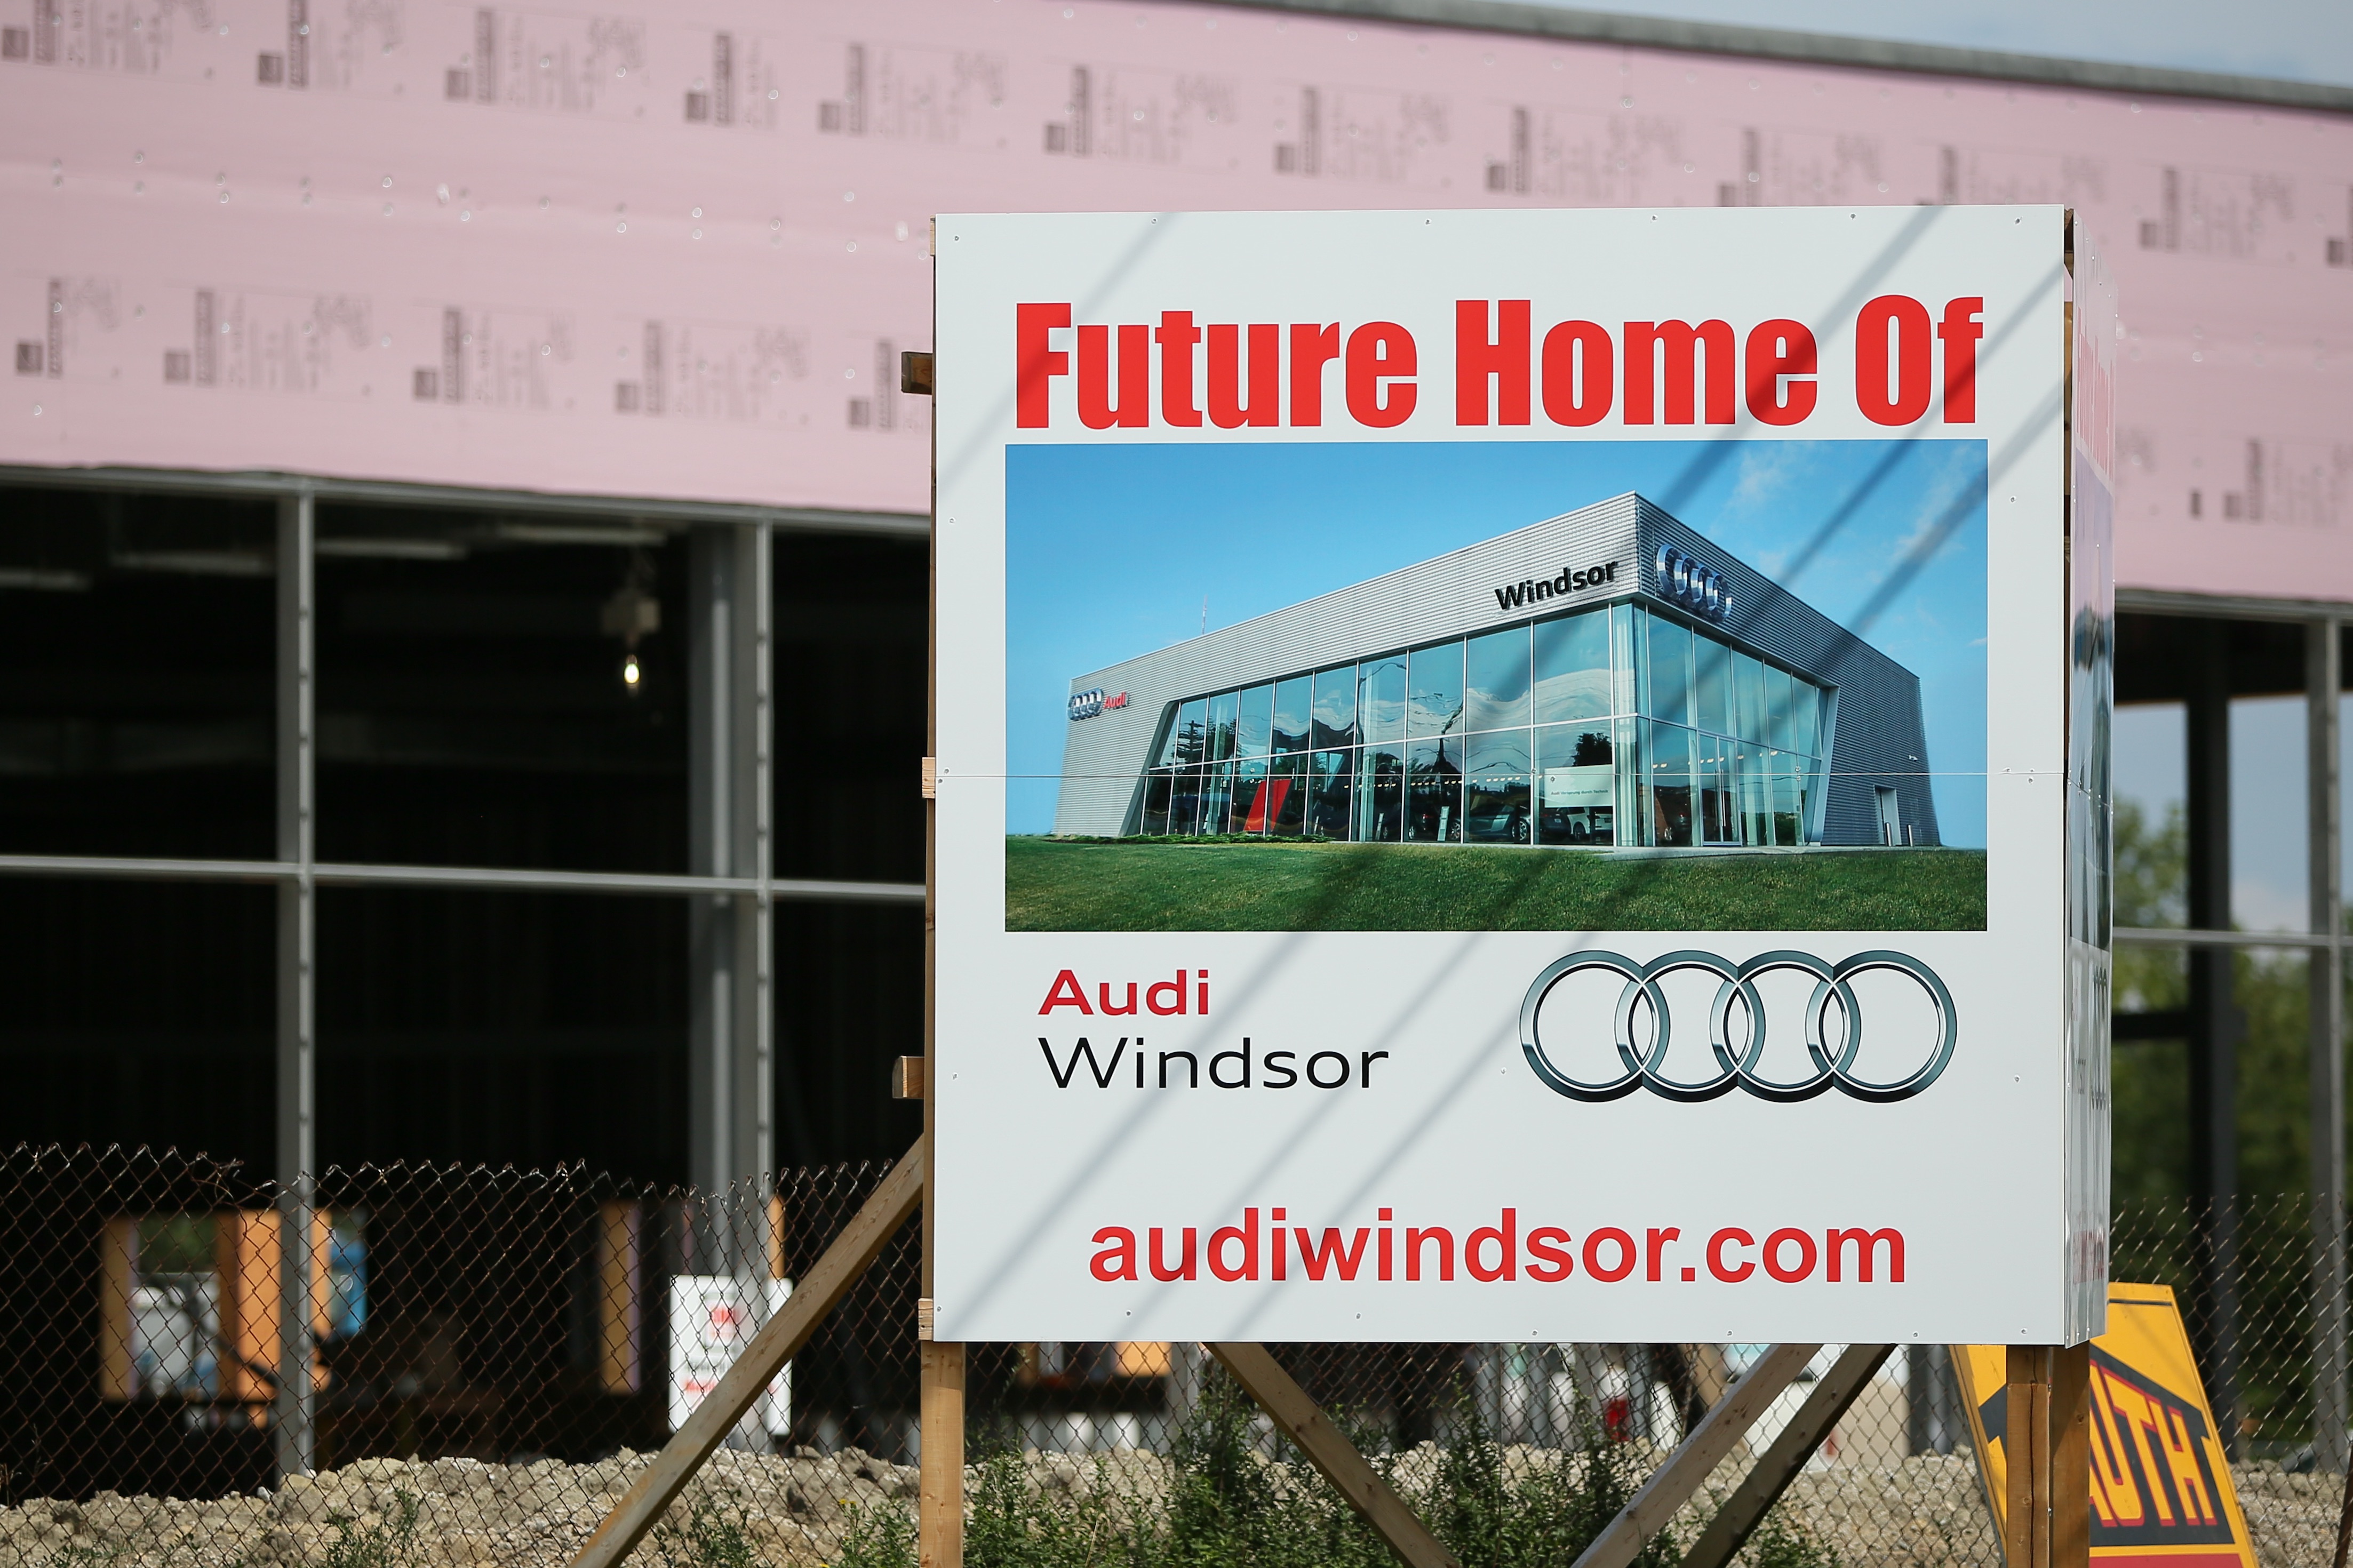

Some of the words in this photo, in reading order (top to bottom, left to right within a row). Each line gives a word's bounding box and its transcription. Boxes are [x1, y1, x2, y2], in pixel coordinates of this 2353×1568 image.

[1017, 302, 1417, 430] Future
[1456, 299, 1817, 427] Home
[1856, 294, 1983, 426] Of
[1495, 561, 1617, 610] Windsor
[1103, 691, 1127, 709] Audi
[1039, 969, 1209, 1016] Audi
[1038, 1037, 1389, 1089] Windsor
[1090, 1207, 1905, 1283] audiwindsor.com
